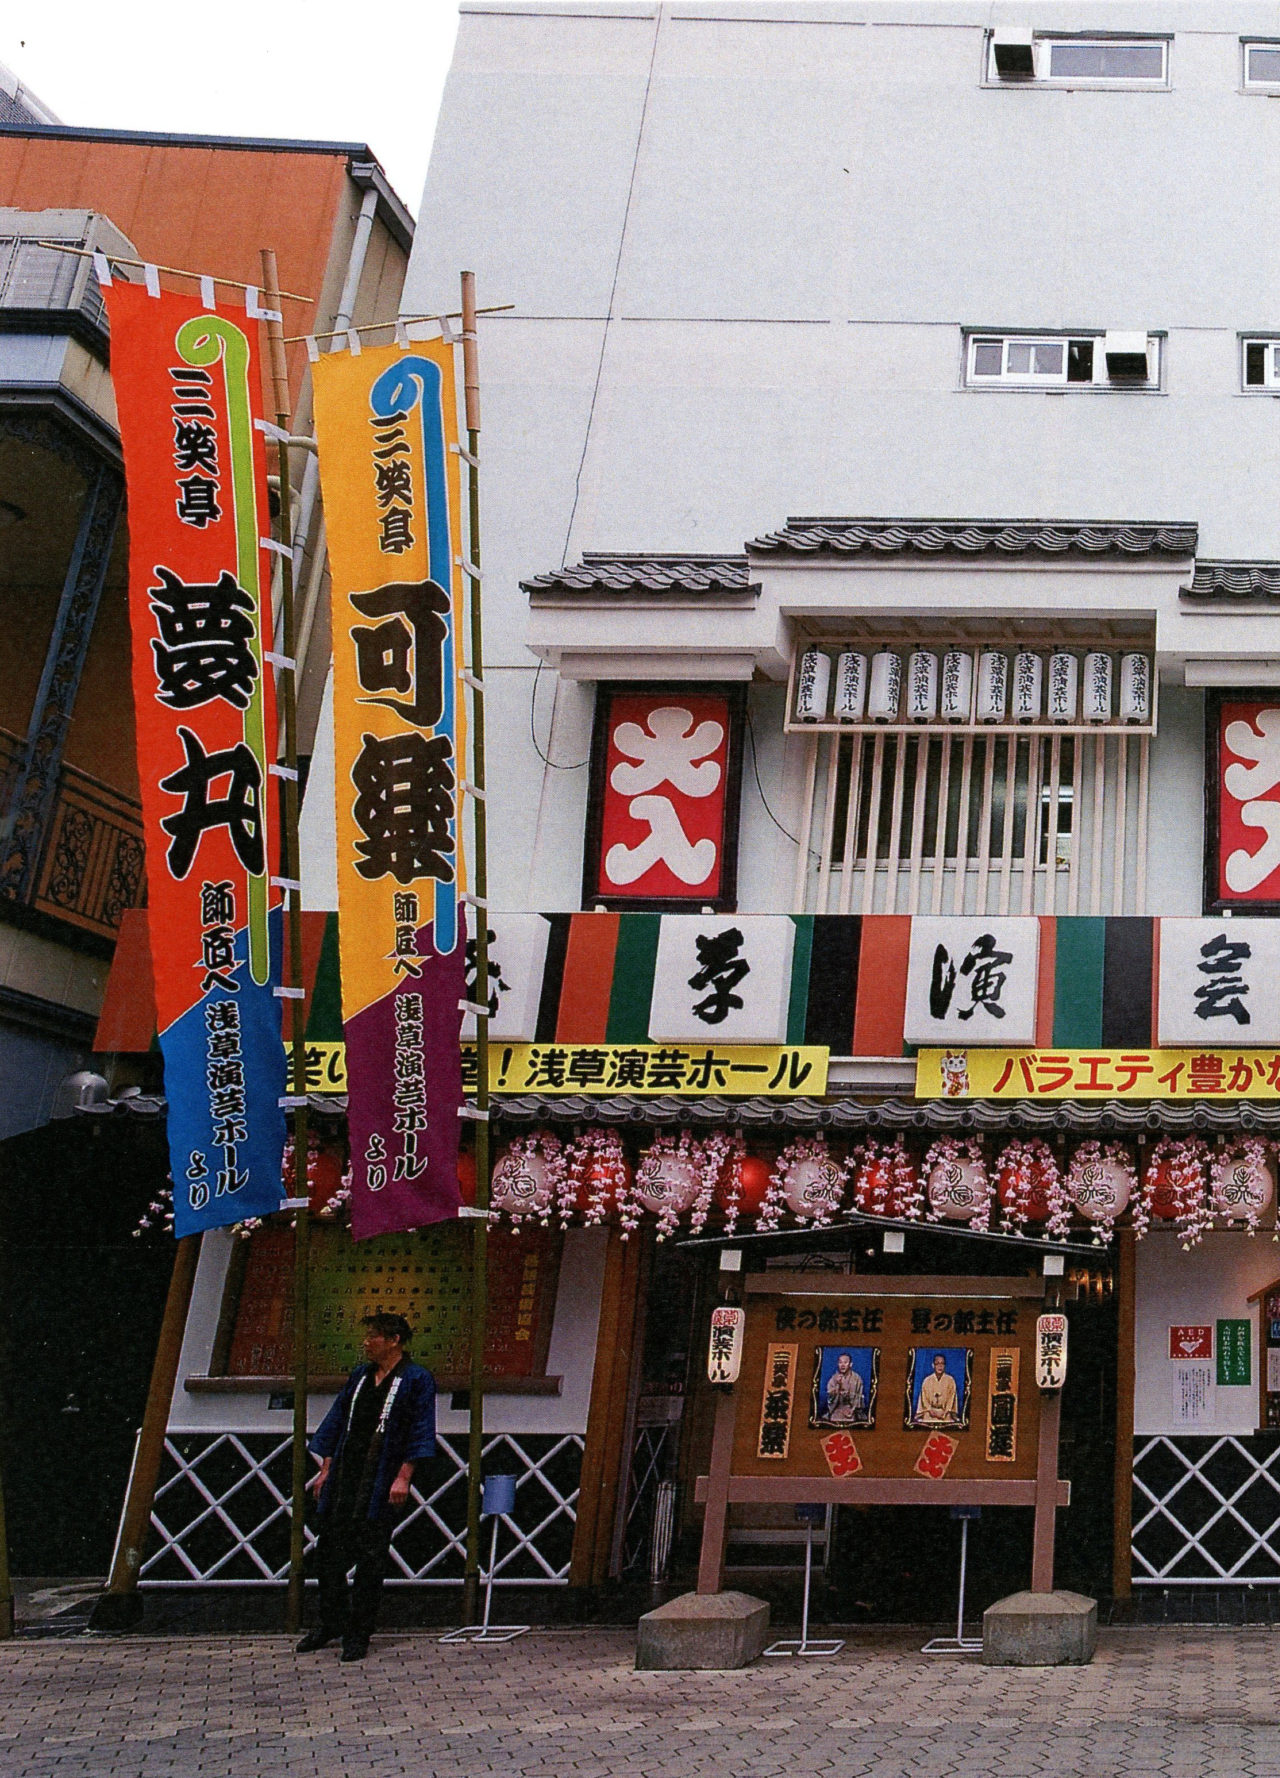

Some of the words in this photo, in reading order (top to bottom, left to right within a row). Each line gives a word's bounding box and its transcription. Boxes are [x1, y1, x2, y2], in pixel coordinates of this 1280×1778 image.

[168, 366, 221, 528] 三笑亭
[368, 411, 416, 554] 三笑亭
[200, 881, 241, 993] 師匠へ
[393, 889, 423, 978] 師匠へ
[205, 1000, 250, 1198] 浅草演芸ホール
[392, 993, 428, 1182] 浅草演芸ホール
[186, 1150, 210, 1210] より
[365, 1133, 387, 1191] より
